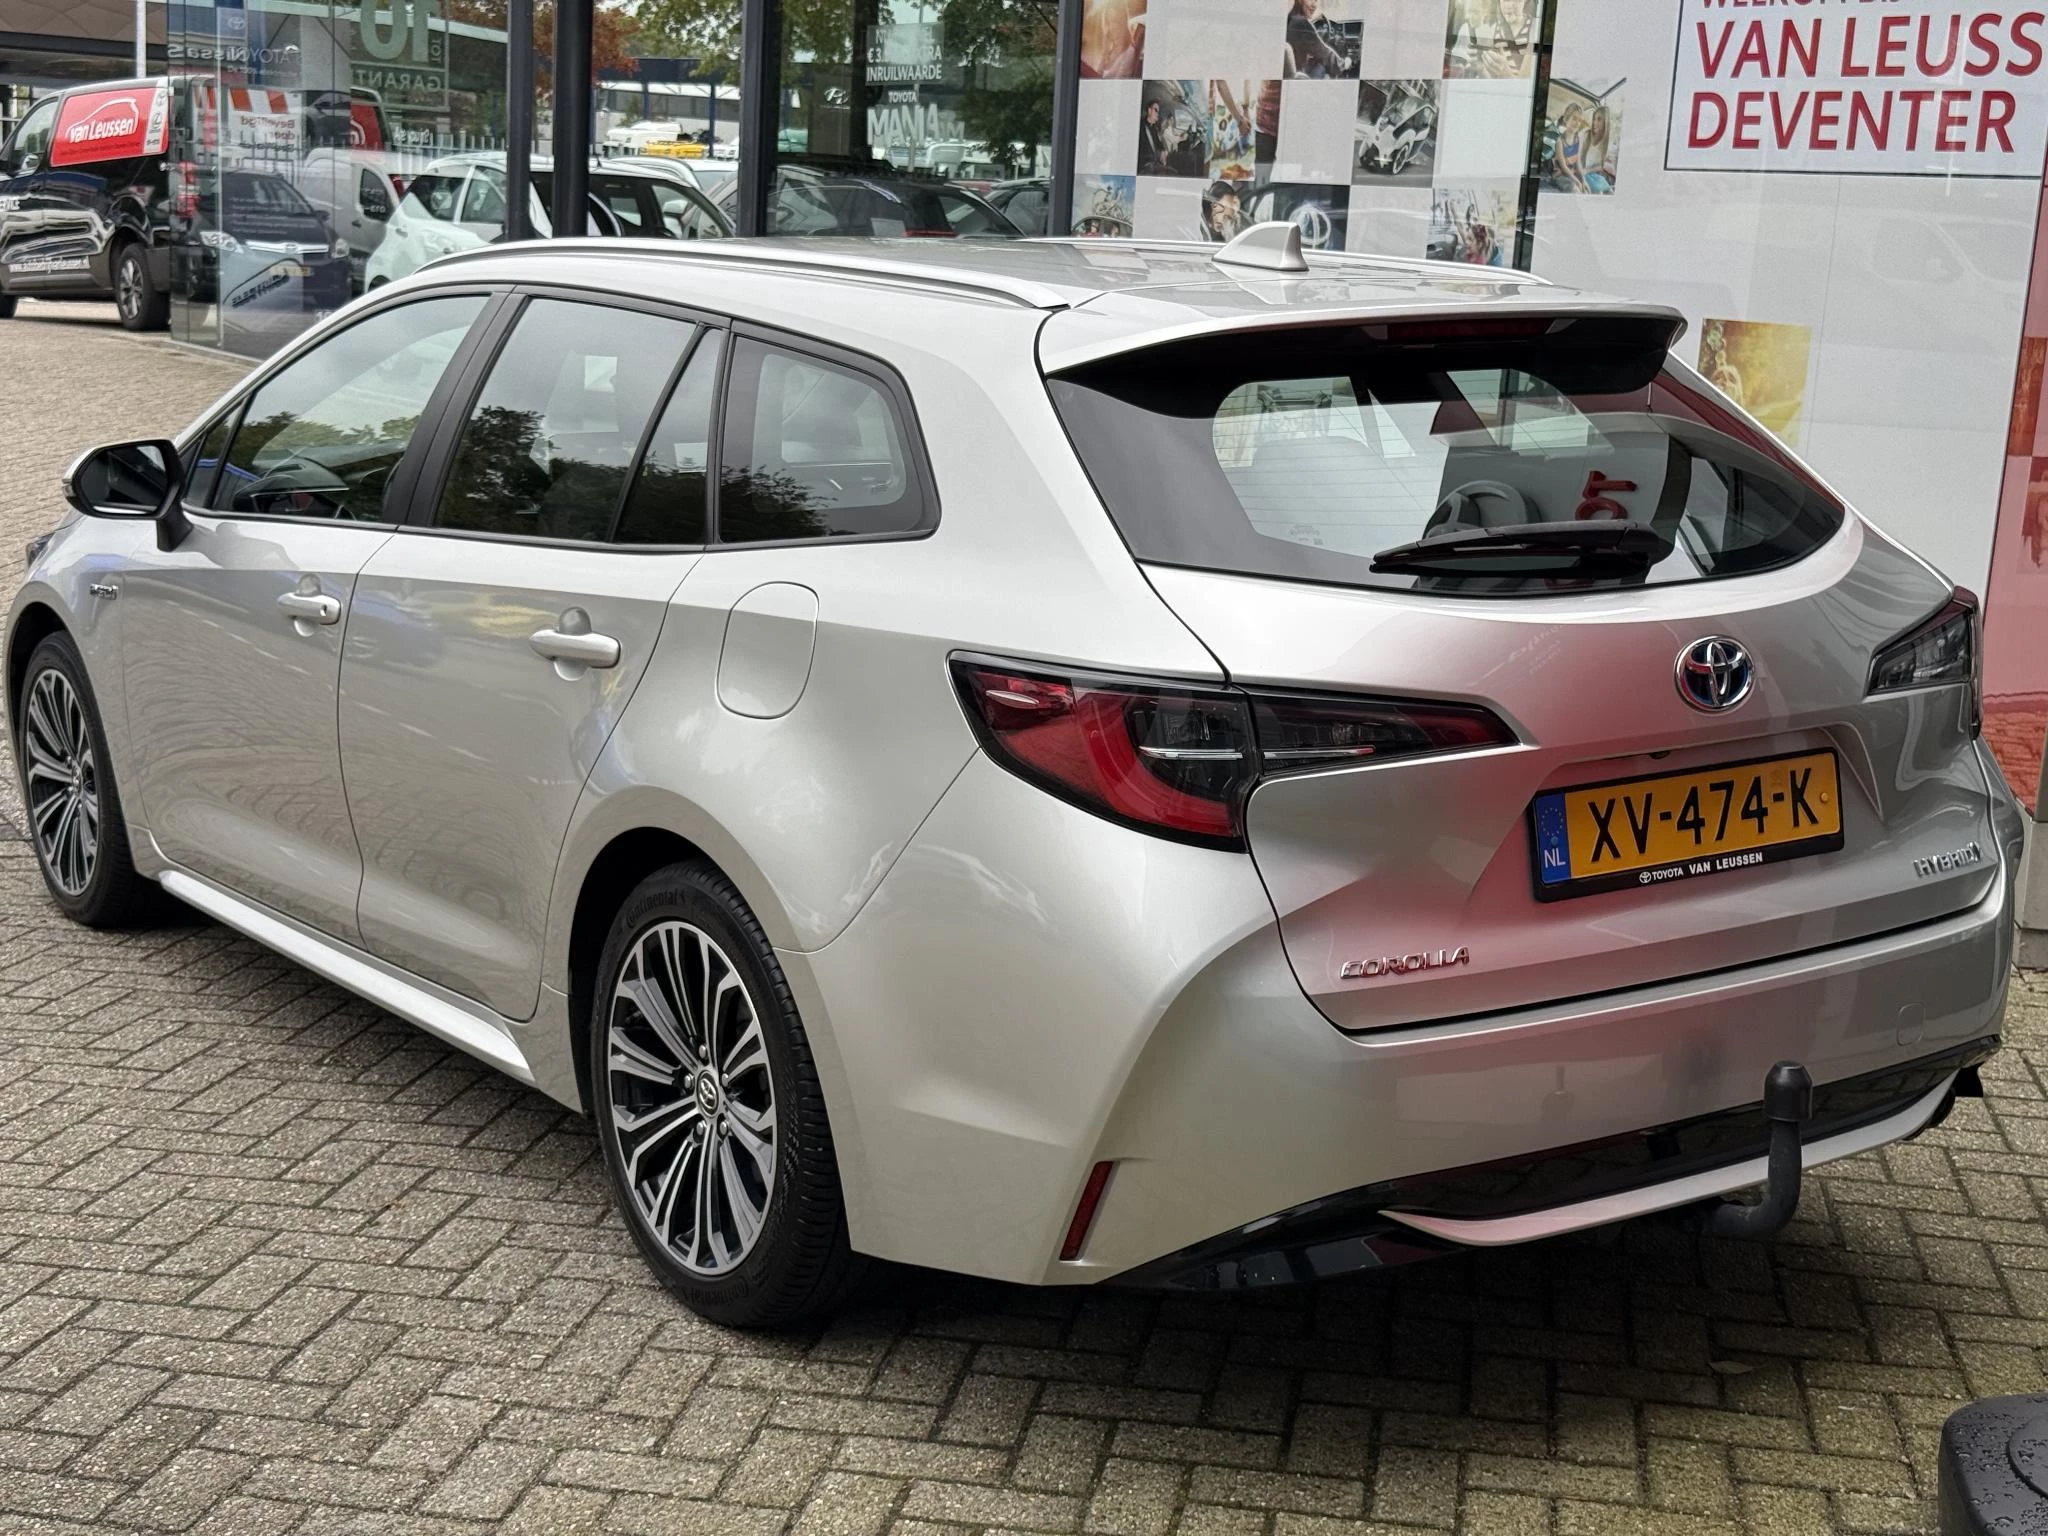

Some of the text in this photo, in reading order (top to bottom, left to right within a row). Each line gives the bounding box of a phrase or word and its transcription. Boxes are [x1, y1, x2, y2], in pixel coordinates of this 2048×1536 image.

[1696, 12, 2046, 79] VAN LEUSS
[866, 64, 943, 82] INRUILWAARDE
[888, 90, 918, 103] TOYOTA
[867, 103, 940, 146] MANIA
[1687, 89, 2016, 153] DEVENTER
[1588, 768, 1820, 863] XV-474-K
[1544, 848, 1567, 869] NL
[1652, 852, 1763, 881] TOYOTA VAN LEUSSEN
[1912, 841, 1981, 878] HYBRID
[1340, 946, 1470, 980] COROLLA
